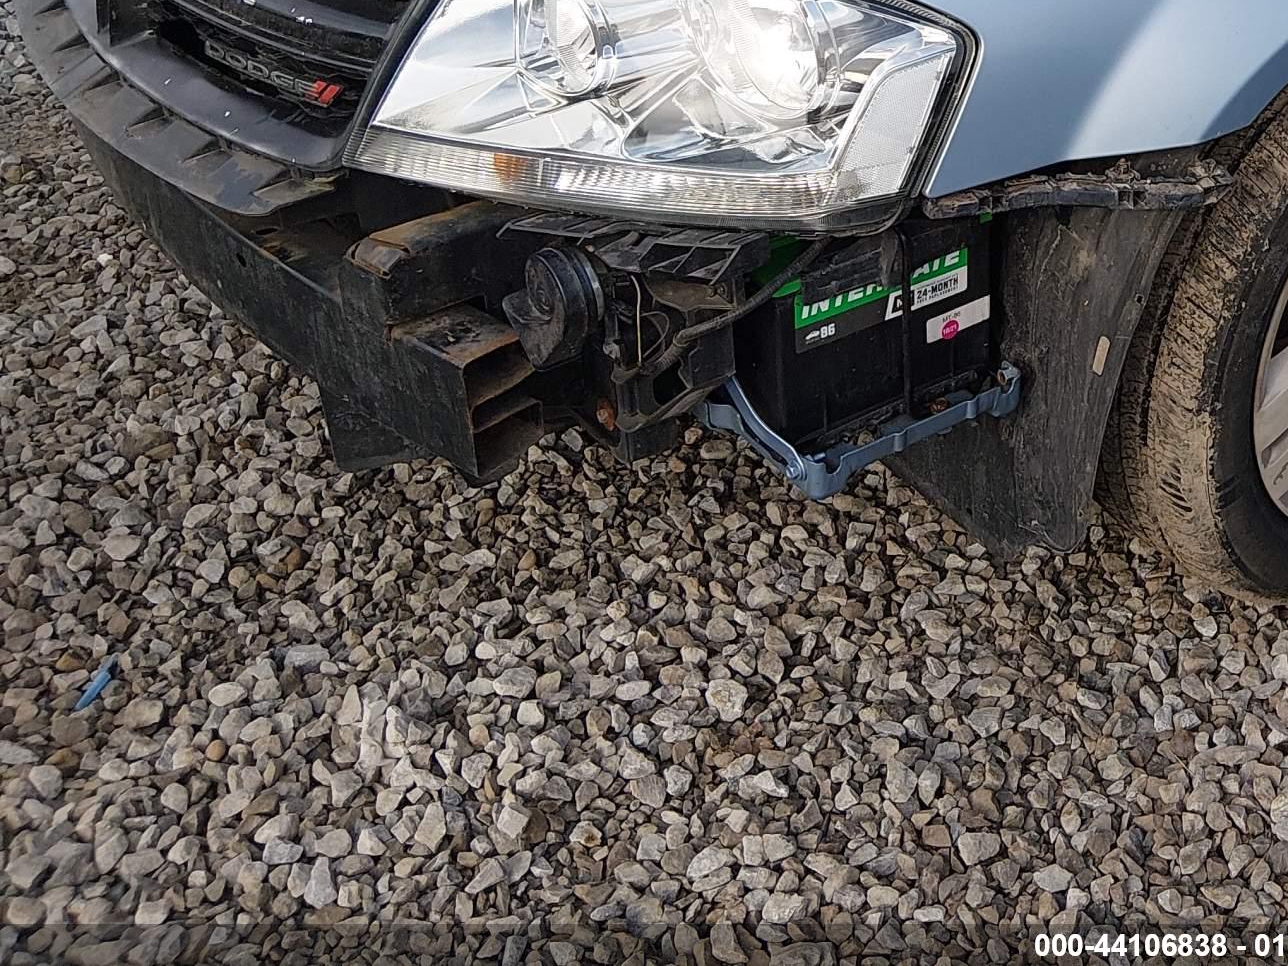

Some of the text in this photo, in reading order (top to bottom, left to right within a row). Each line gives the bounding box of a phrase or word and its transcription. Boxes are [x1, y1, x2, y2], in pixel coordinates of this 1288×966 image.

[205, 42, 321, 97] DODGE
[916, 275, 959, 300] 24-MONTH
[820, 323, 836, 339] 86
